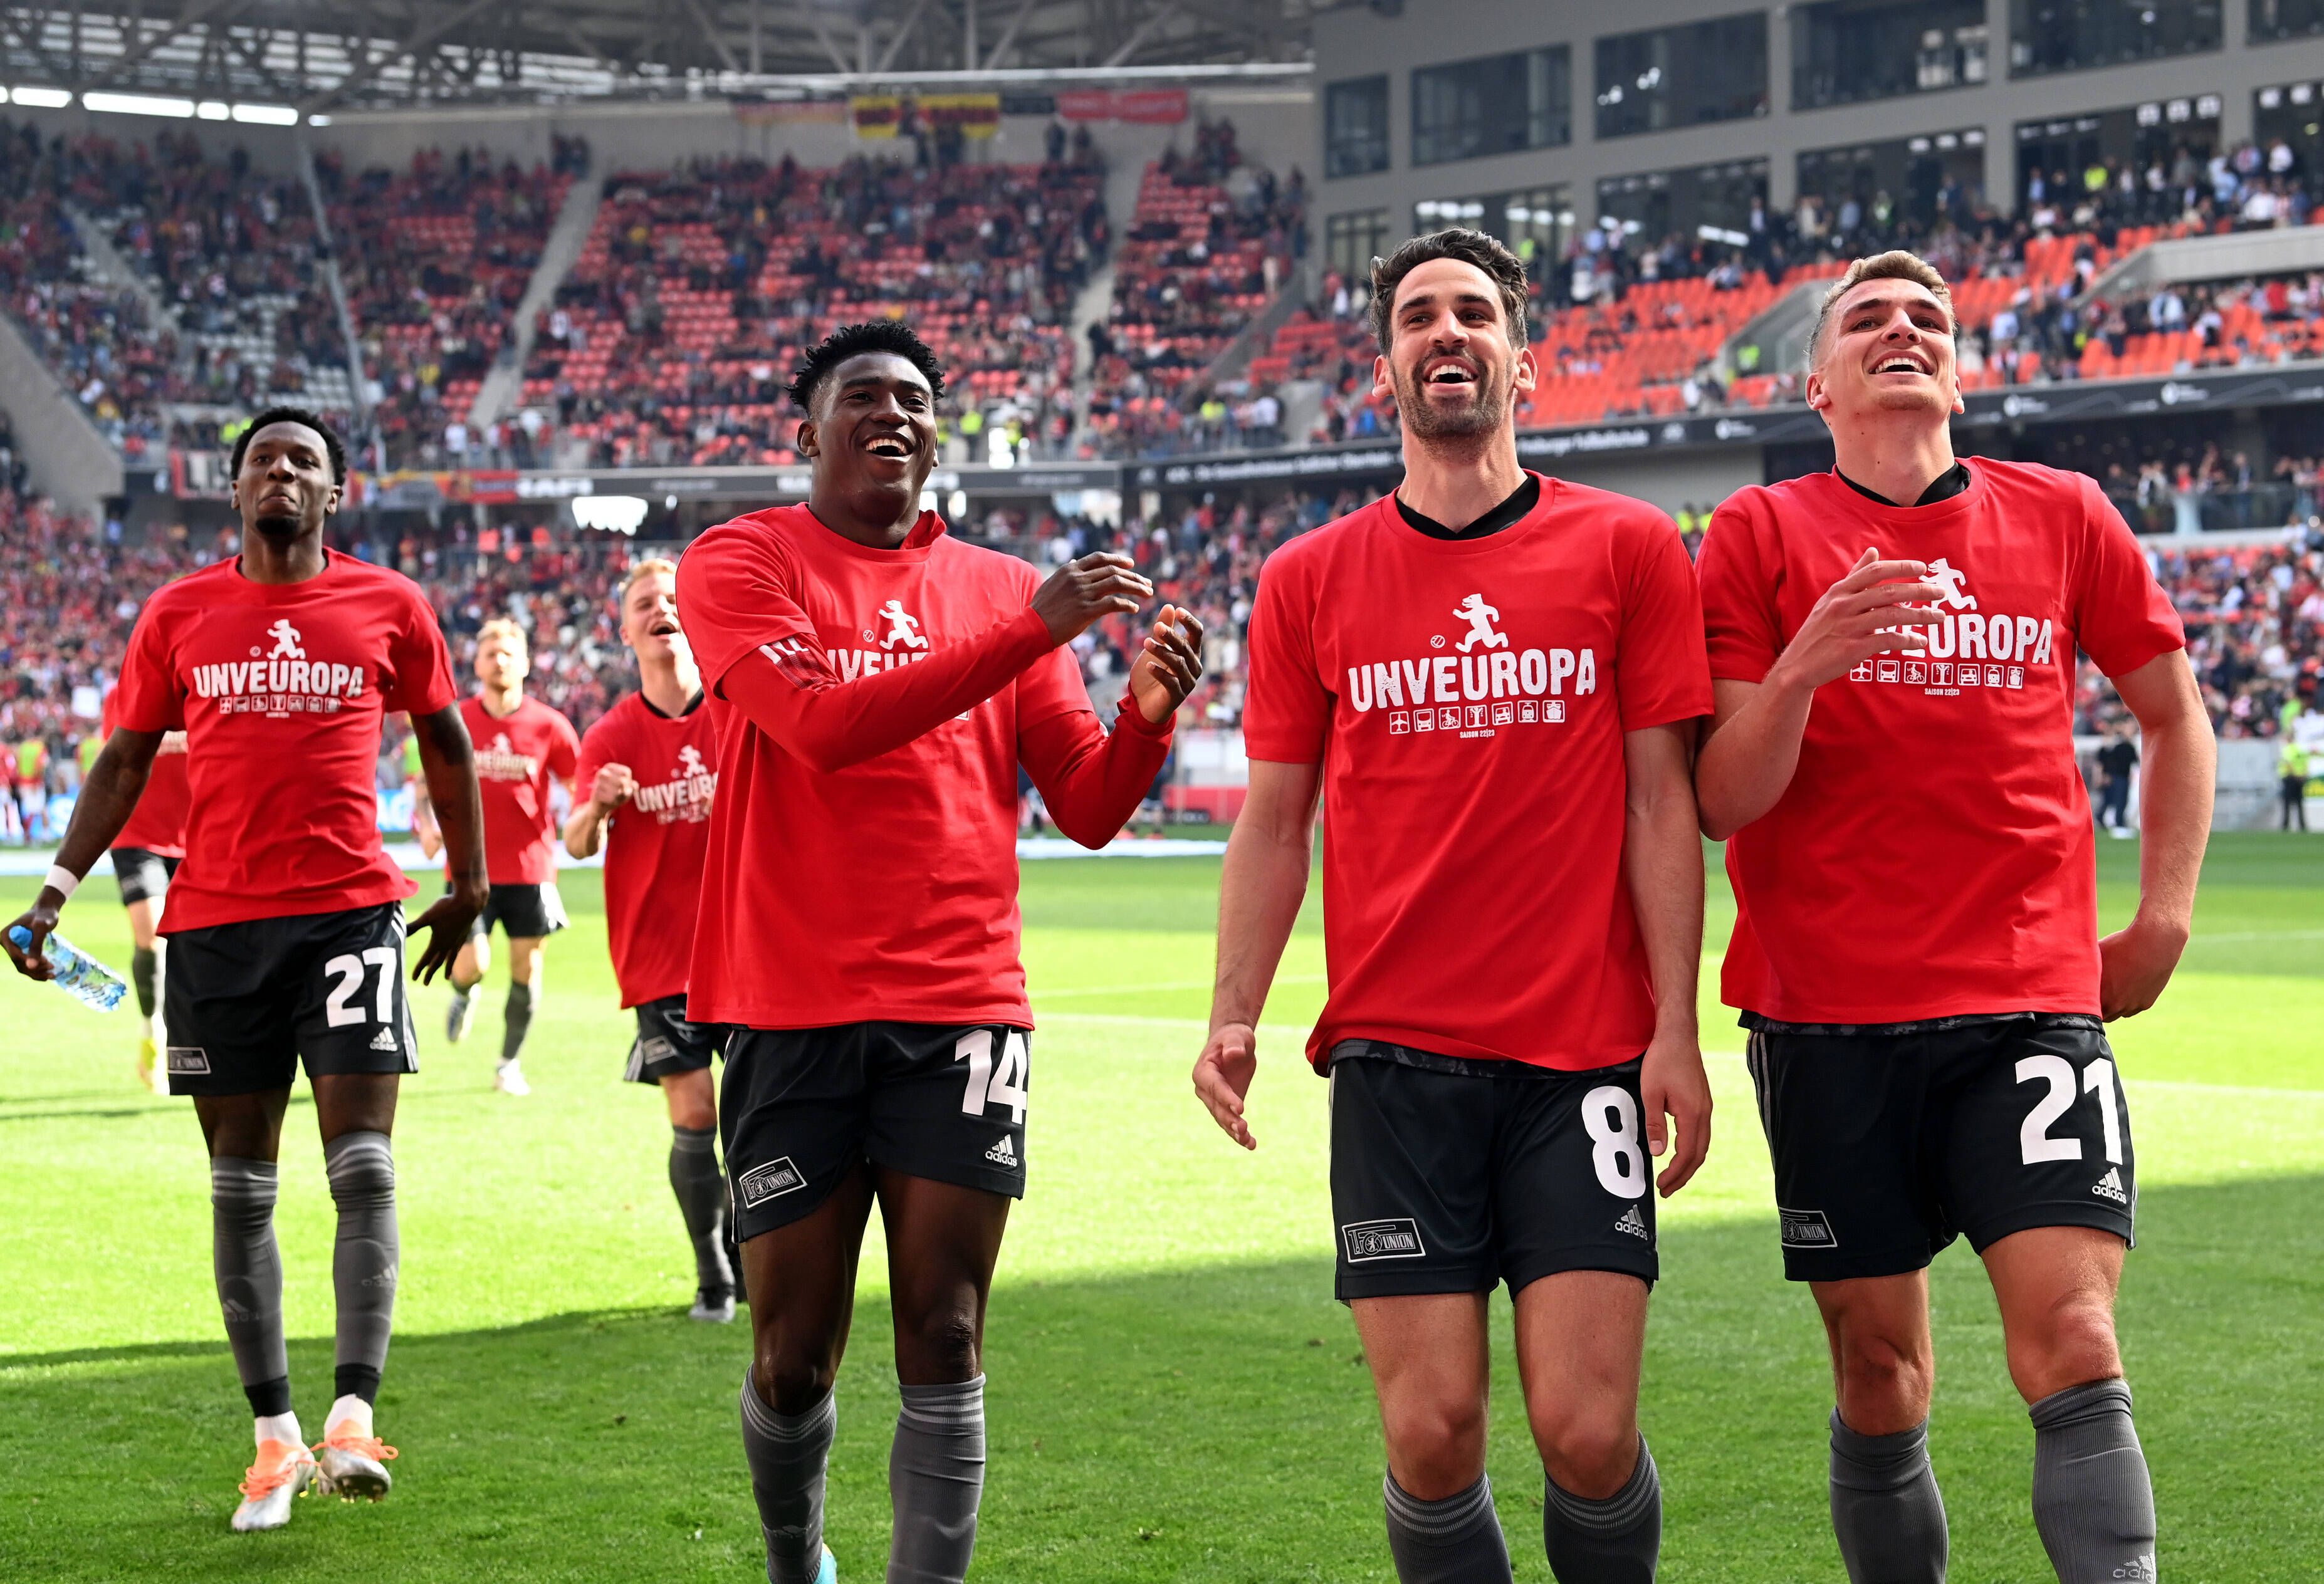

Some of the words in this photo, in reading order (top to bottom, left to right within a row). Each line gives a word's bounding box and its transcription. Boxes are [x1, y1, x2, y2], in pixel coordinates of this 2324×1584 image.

[1874, 614, 2052, 664] EUROPA
[192, 660, 364, 698] UNVEUROPA
[1348, 649, 1596, 712] UNVEUROPA
[1924, 687, 1944, 696] SAISON
[1460, 731, 1479, 739] SAISON
[634, 771, 718, 813] UNVEUR
[325, 947, 397, 1028] 27
[955, 1028, 1027, 1125] 14
[2014, 1055, 2123, 1165] 21
[1581, 1085, 1646, 1199] 8
[985, 1150, 1017, 1167] adidas
[767, 1170, 795, 1189] UNION
[2092, 1184, 2127, 1204] adidas
[1382, 1234, 1414, 1249] UNION
[1615, 1221, 1648, 1241] adidas
[1799, 1225, 1826, 1239] UNION
